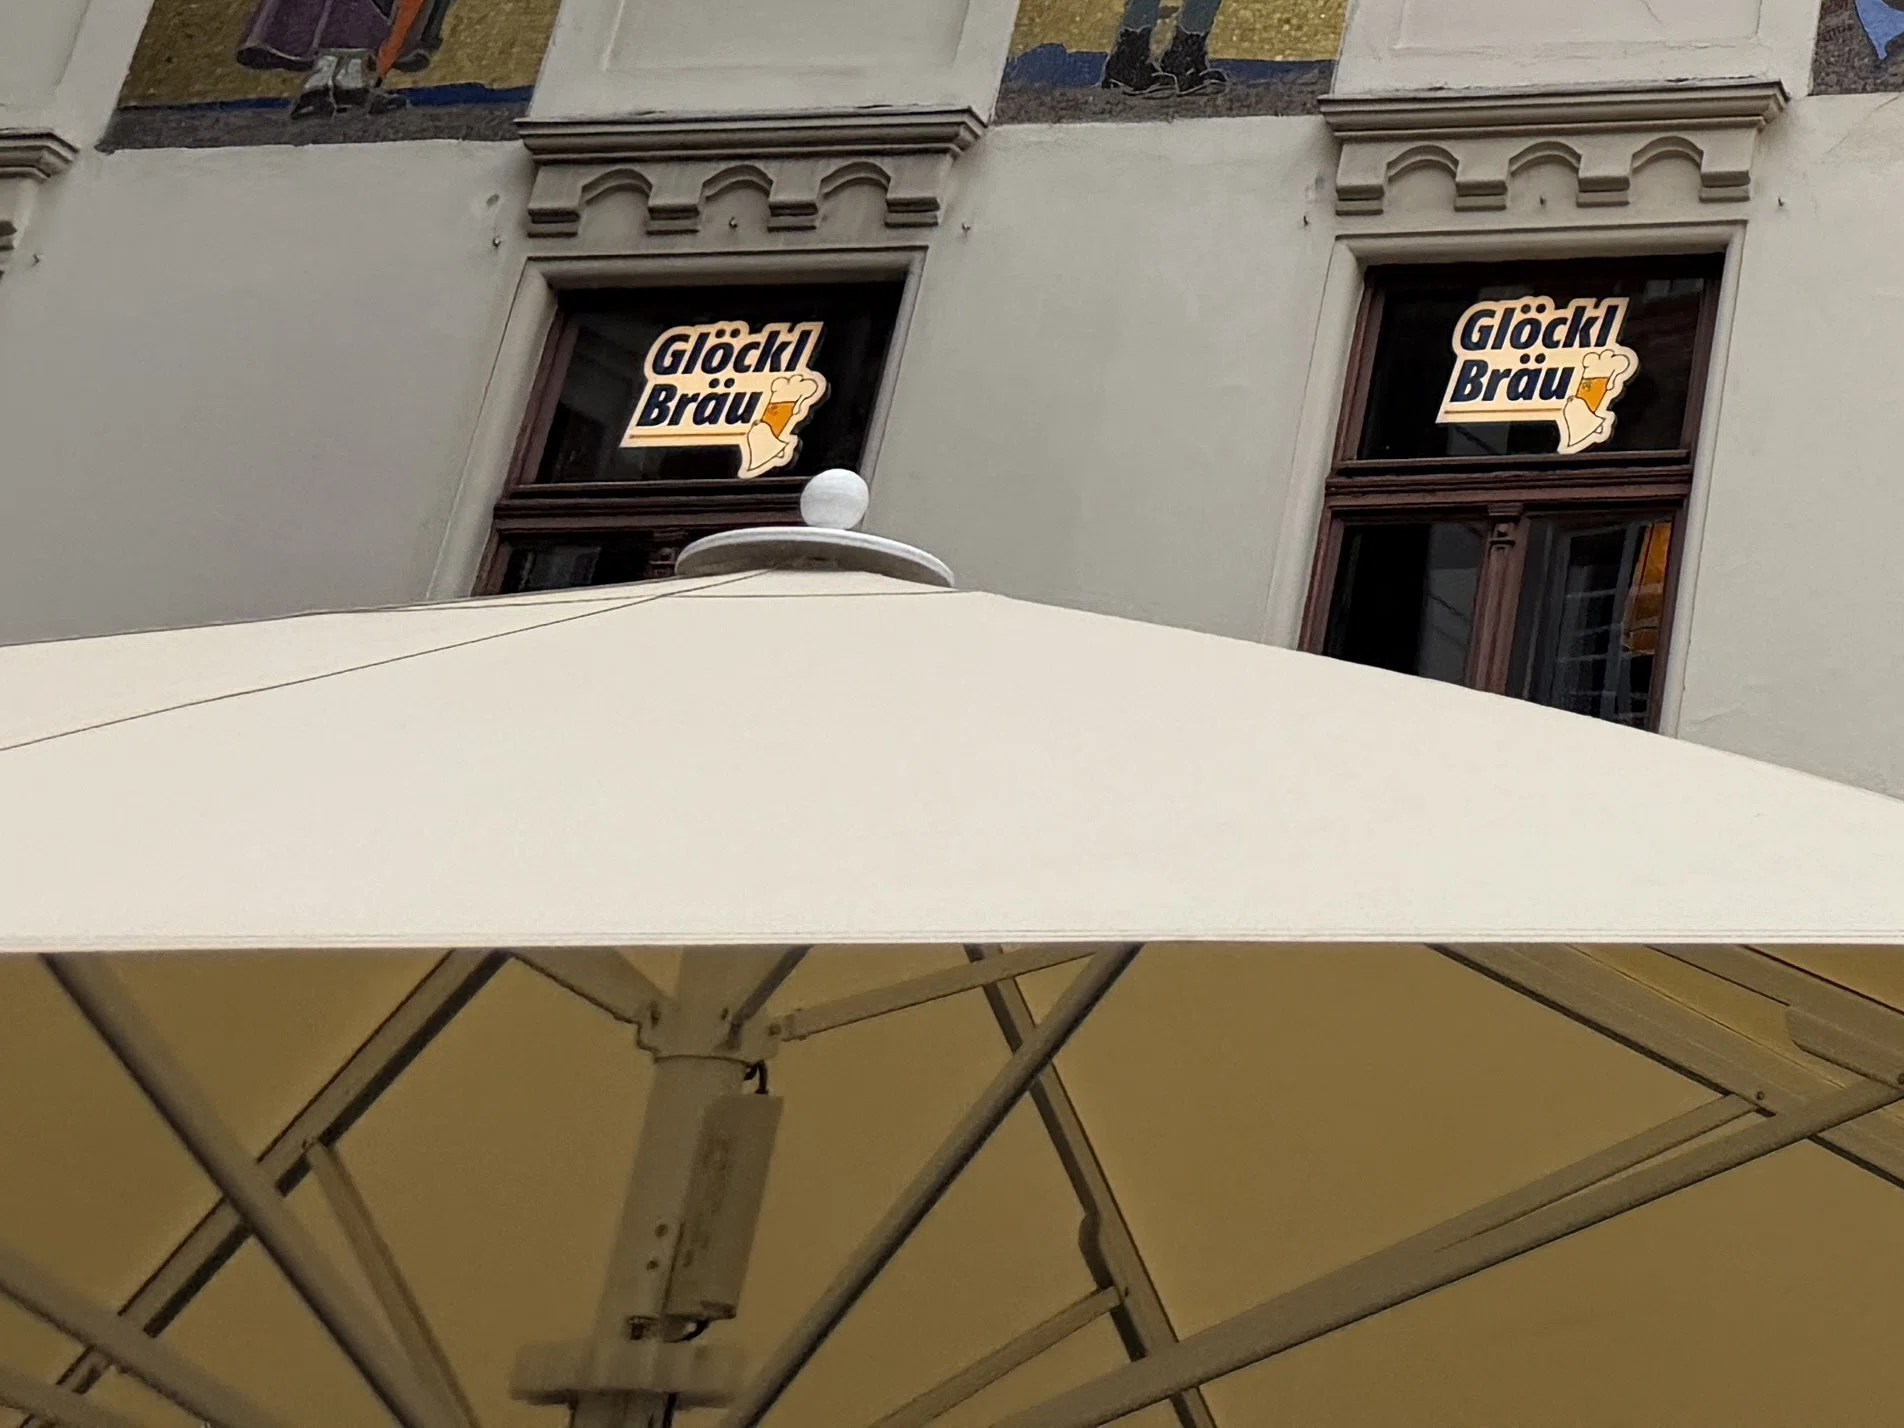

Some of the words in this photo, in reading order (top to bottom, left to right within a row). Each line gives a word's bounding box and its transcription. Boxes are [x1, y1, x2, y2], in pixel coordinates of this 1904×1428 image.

[1460, 303, 1620, 351] Glöckl
[652, 328, 813, 376] Glöckl
[636, 377, 764, 427] Bräu
[1449, 353, 1576, 403] Bräu
